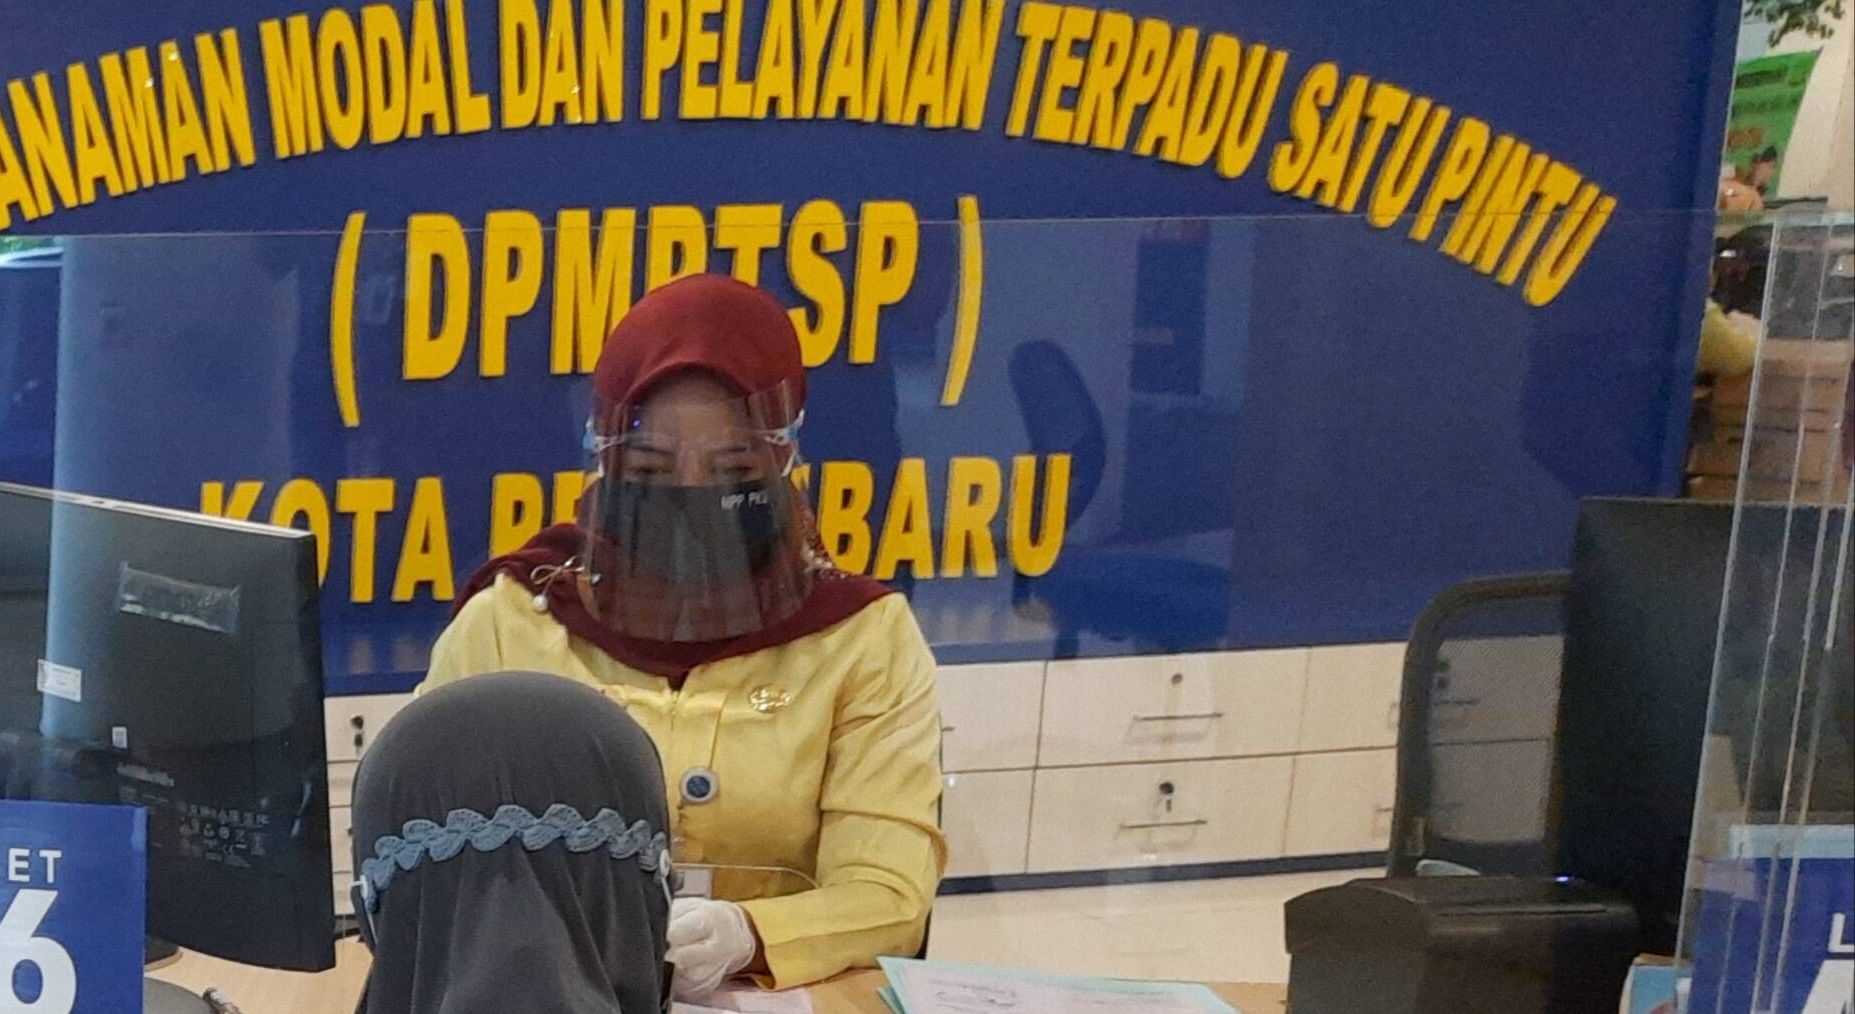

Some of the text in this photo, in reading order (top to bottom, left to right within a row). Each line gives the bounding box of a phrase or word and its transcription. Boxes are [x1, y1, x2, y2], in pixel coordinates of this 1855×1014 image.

[259, 1, 489, 158] MODAL
[500, 0, 624, 129] DAN
[642, 0, 1004, 130] PELAYANAN
[1005, 1, 1289, 178] TERPADU
[1267, 62, 1451, 228] SATU
[1410, 116, 1617, 306] PINTU
